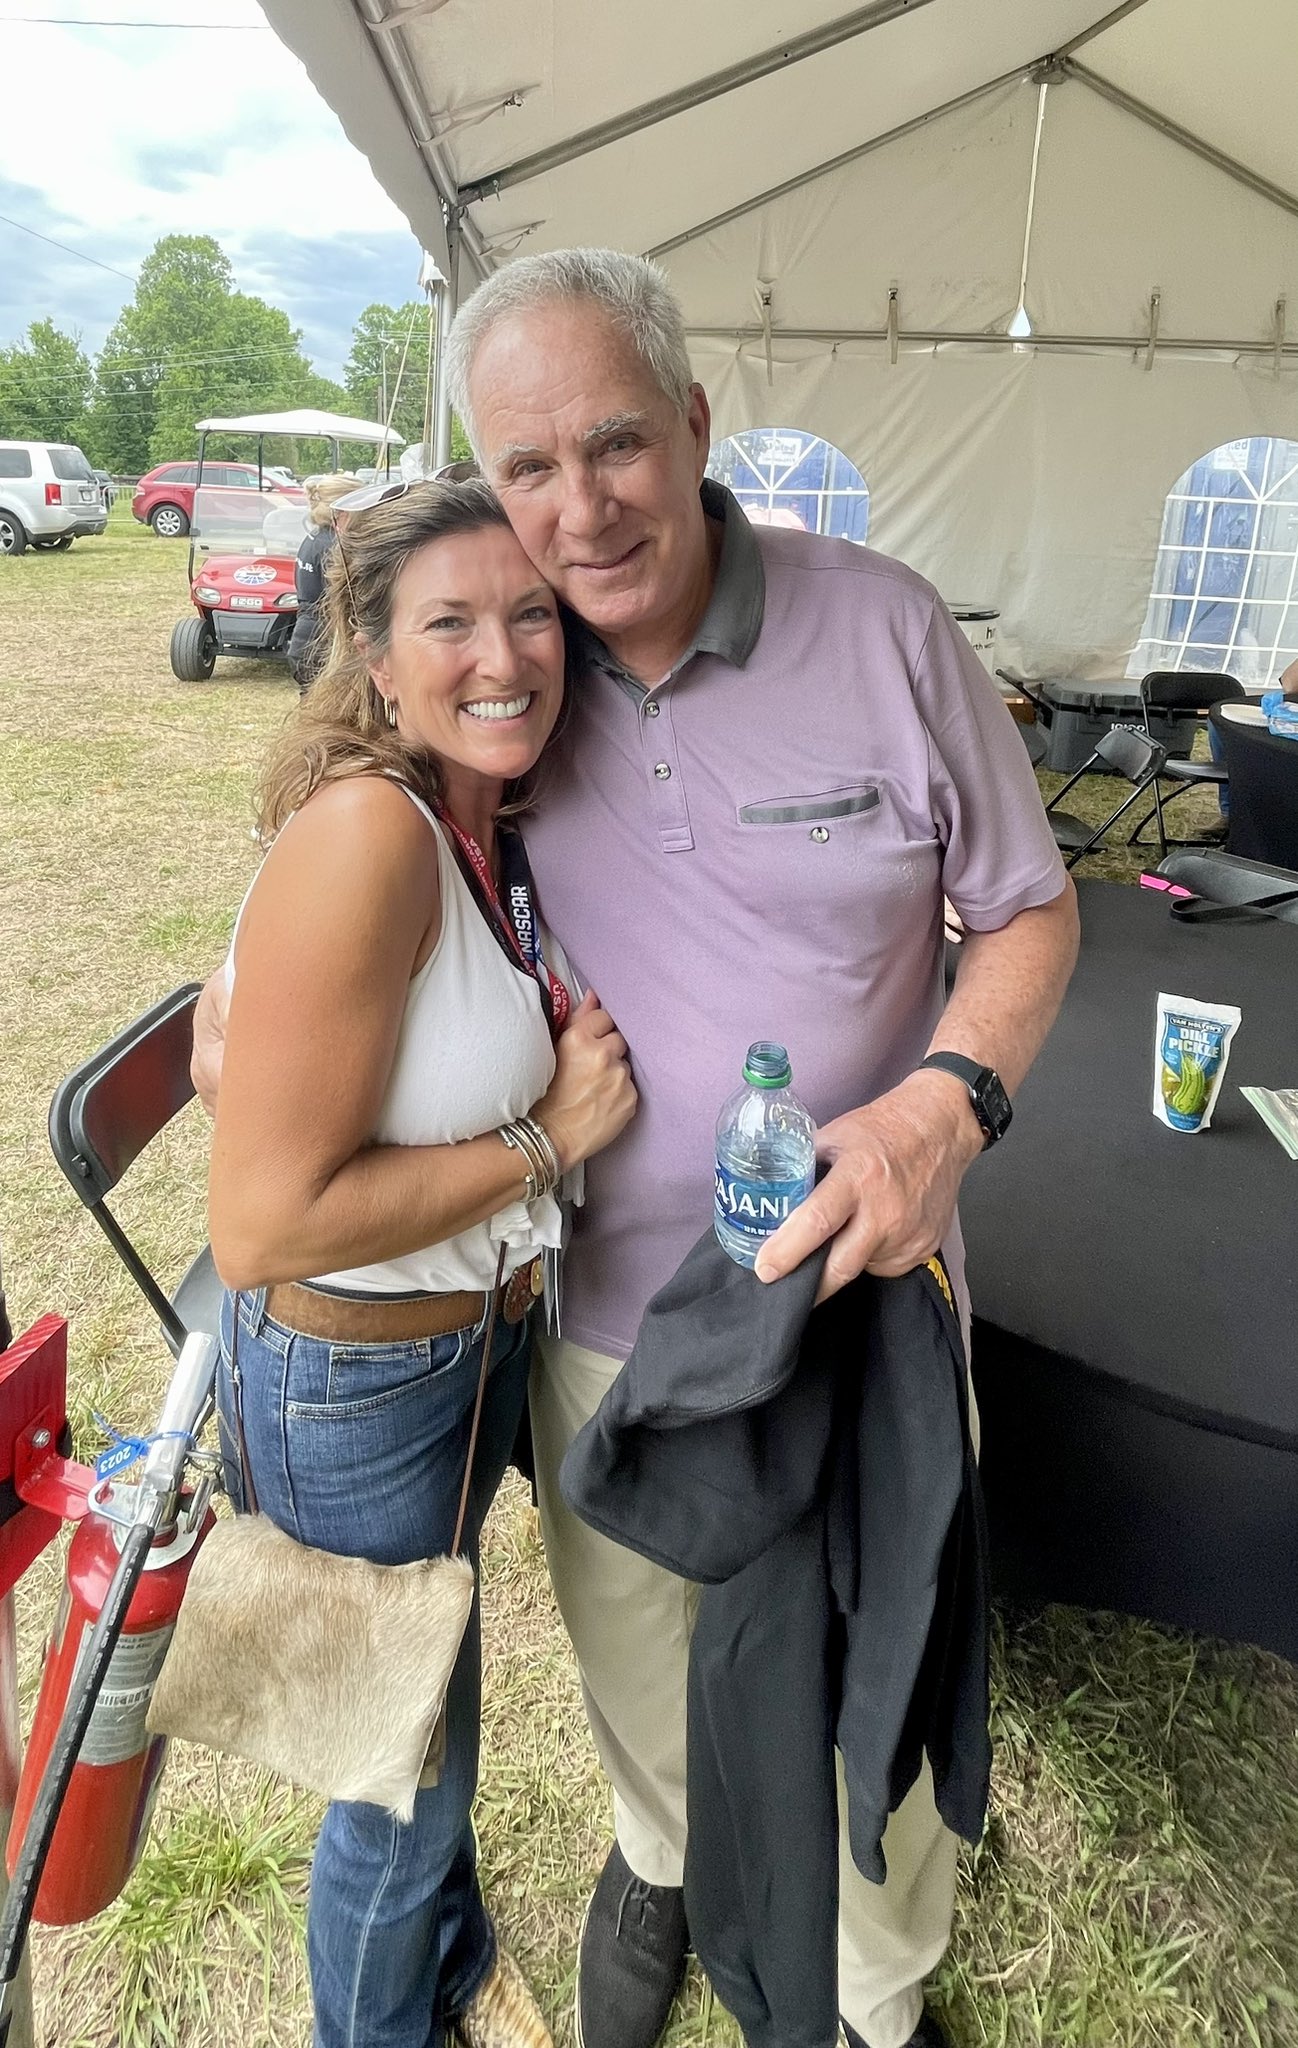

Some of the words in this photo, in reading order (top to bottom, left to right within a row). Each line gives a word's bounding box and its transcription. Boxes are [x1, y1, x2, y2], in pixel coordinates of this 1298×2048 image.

[468, 836, 487, 868] USA
[510, 885, 529, 955] NASCAR
[552, 984, 562, 1016] USA
[1168, 1036, 1220, 1059] PICKLE
[1179, 1028, 1211, 1045] DILL
[100, 1445, 131, 1473] 2023
